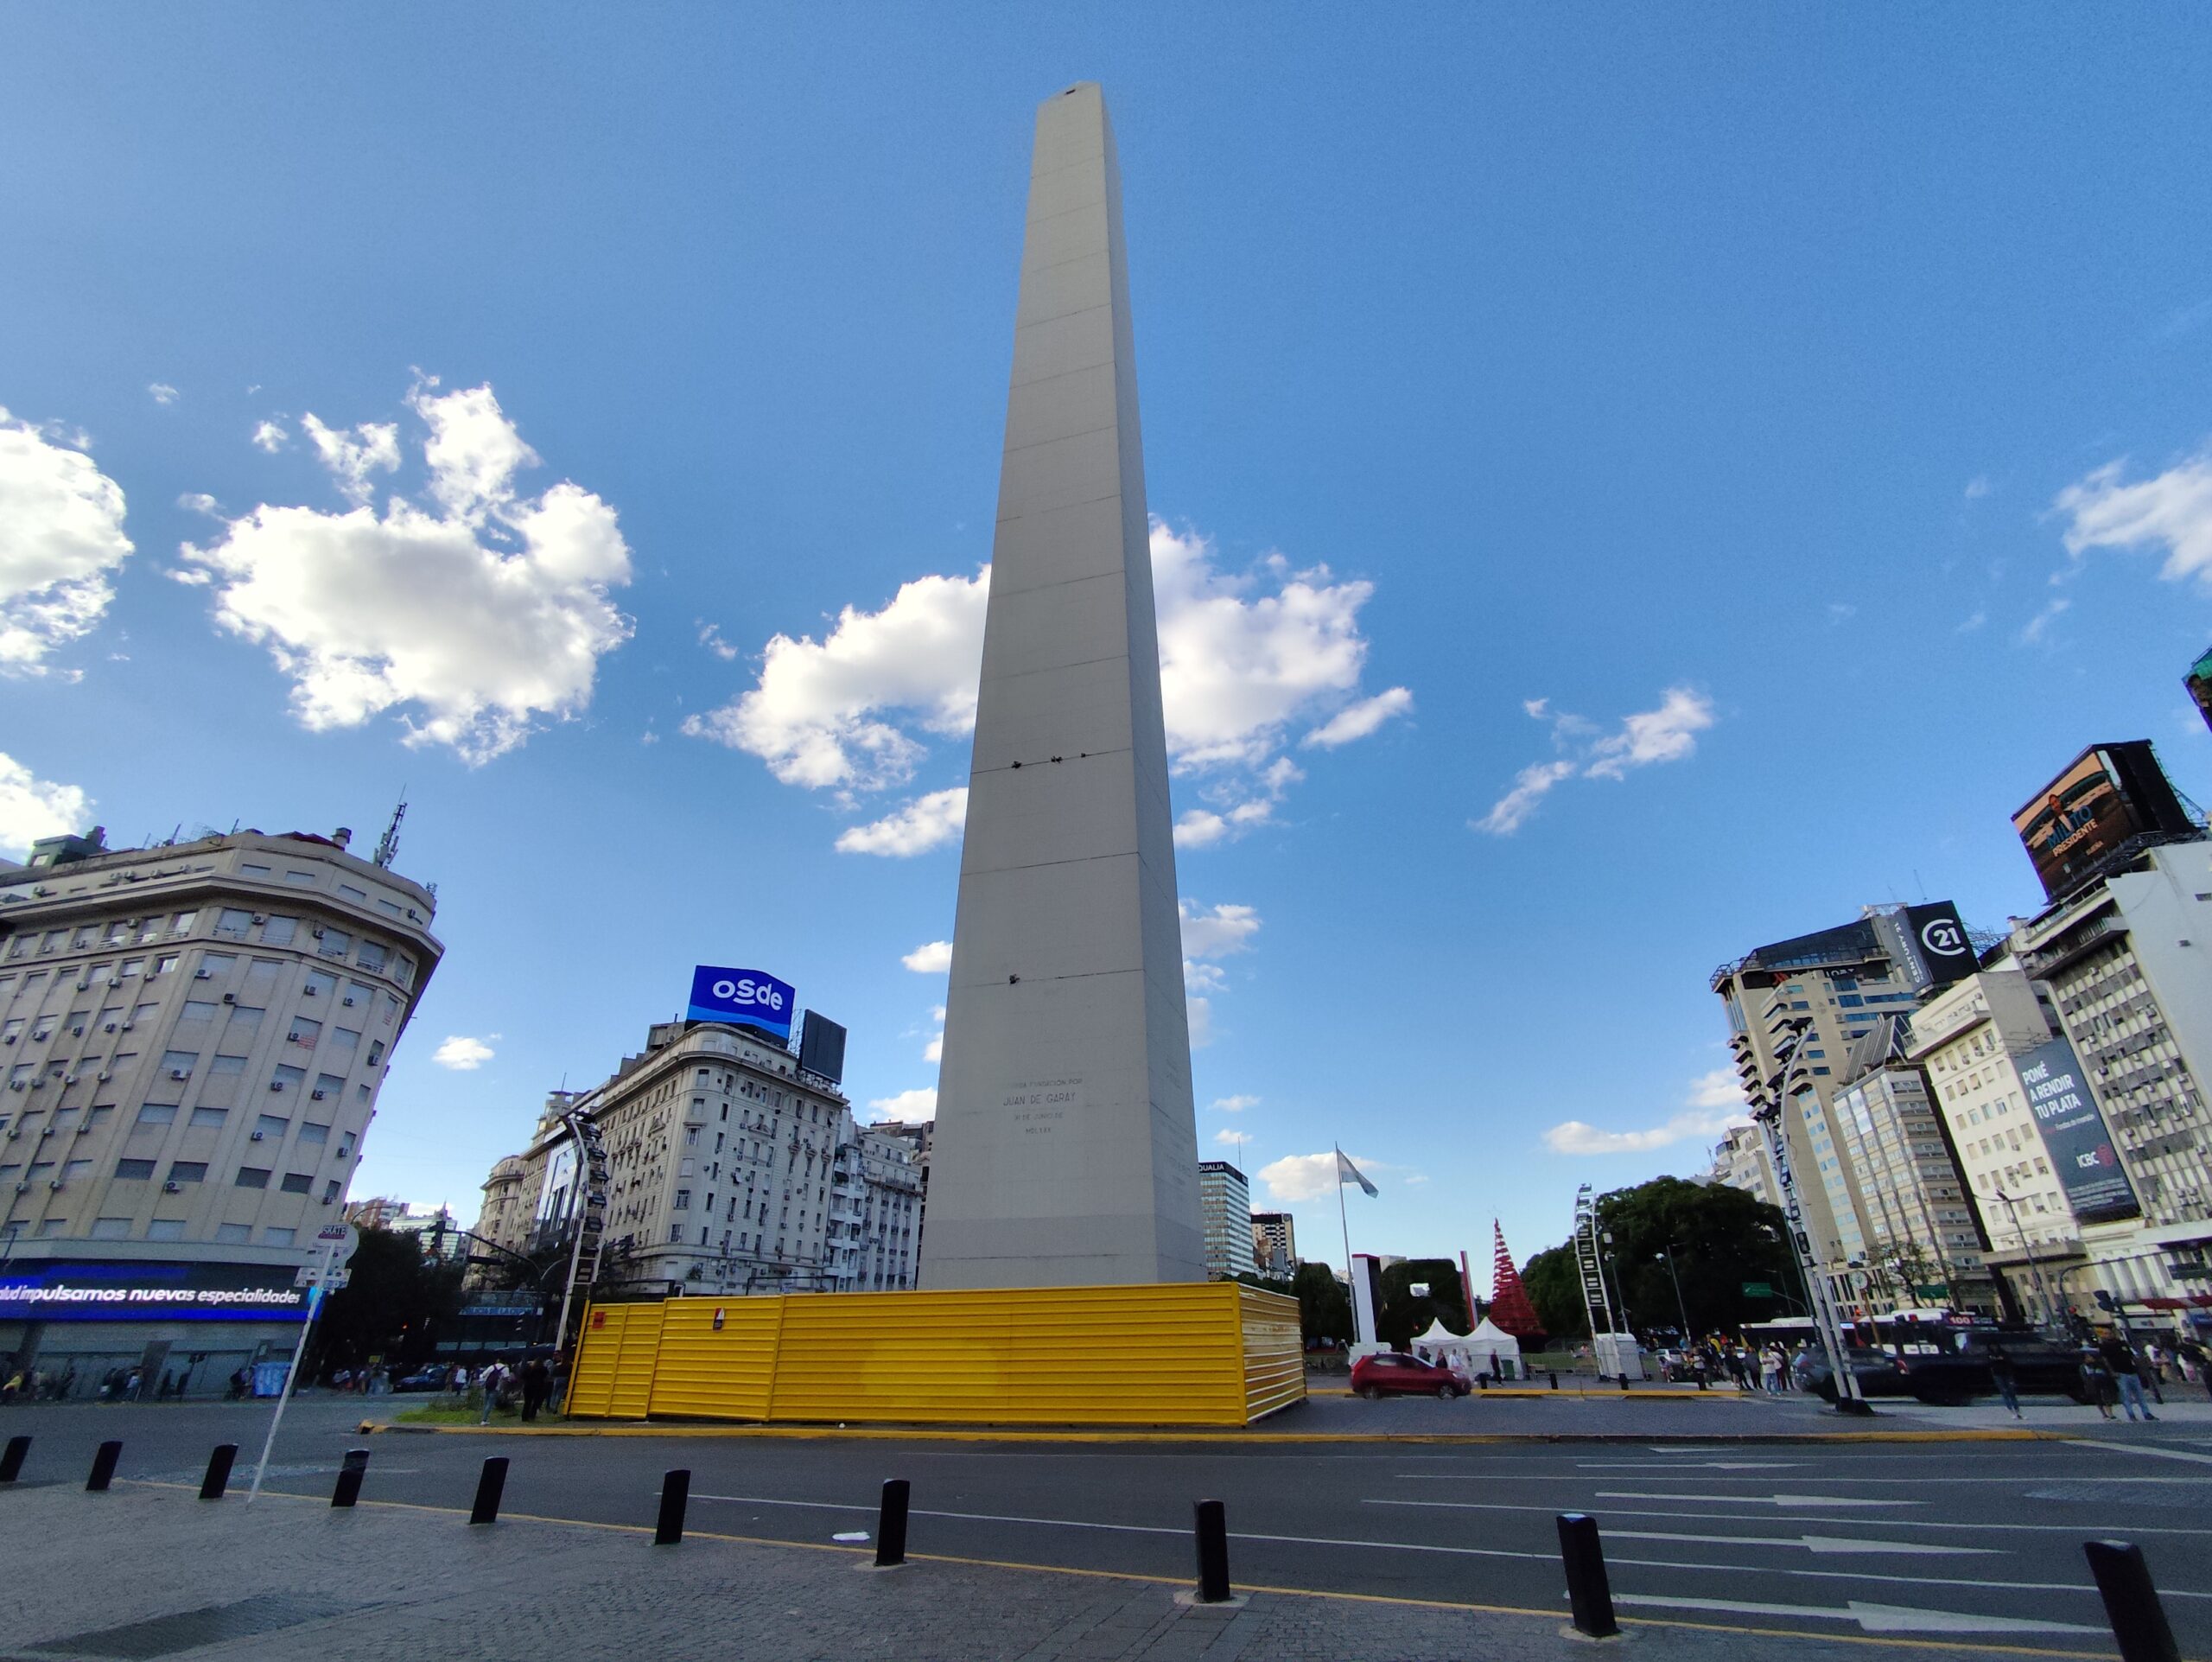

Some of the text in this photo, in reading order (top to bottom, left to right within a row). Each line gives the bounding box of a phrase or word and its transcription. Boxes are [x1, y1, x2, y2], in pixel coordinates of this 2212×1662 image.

[2047, 806, 2092, 849] MILTO
[2053, 818, 2098, 856] PRESIDENTE
[1898, 935, 1920, 983] CENTURY
[713, 979, 783, 1010] osde
[2022, 1060, 2050, 1086] PONÉ
[1003, 1092, 1076, 1106] JUAN DE GARAY
[2030, 1073, 2075, 1102] A RENDIR
[2035, 1093, 2082, 1119] TU PLATA
[2076, 1151, 2100, 1168] ICBC
[20, 1285, 127, 1304] impulsamos
[129, 1289, 196, 1302] nuevas
[197, 1288, 301, 1306] especialidades
[1949, 1316, 1971, 1325] 100
